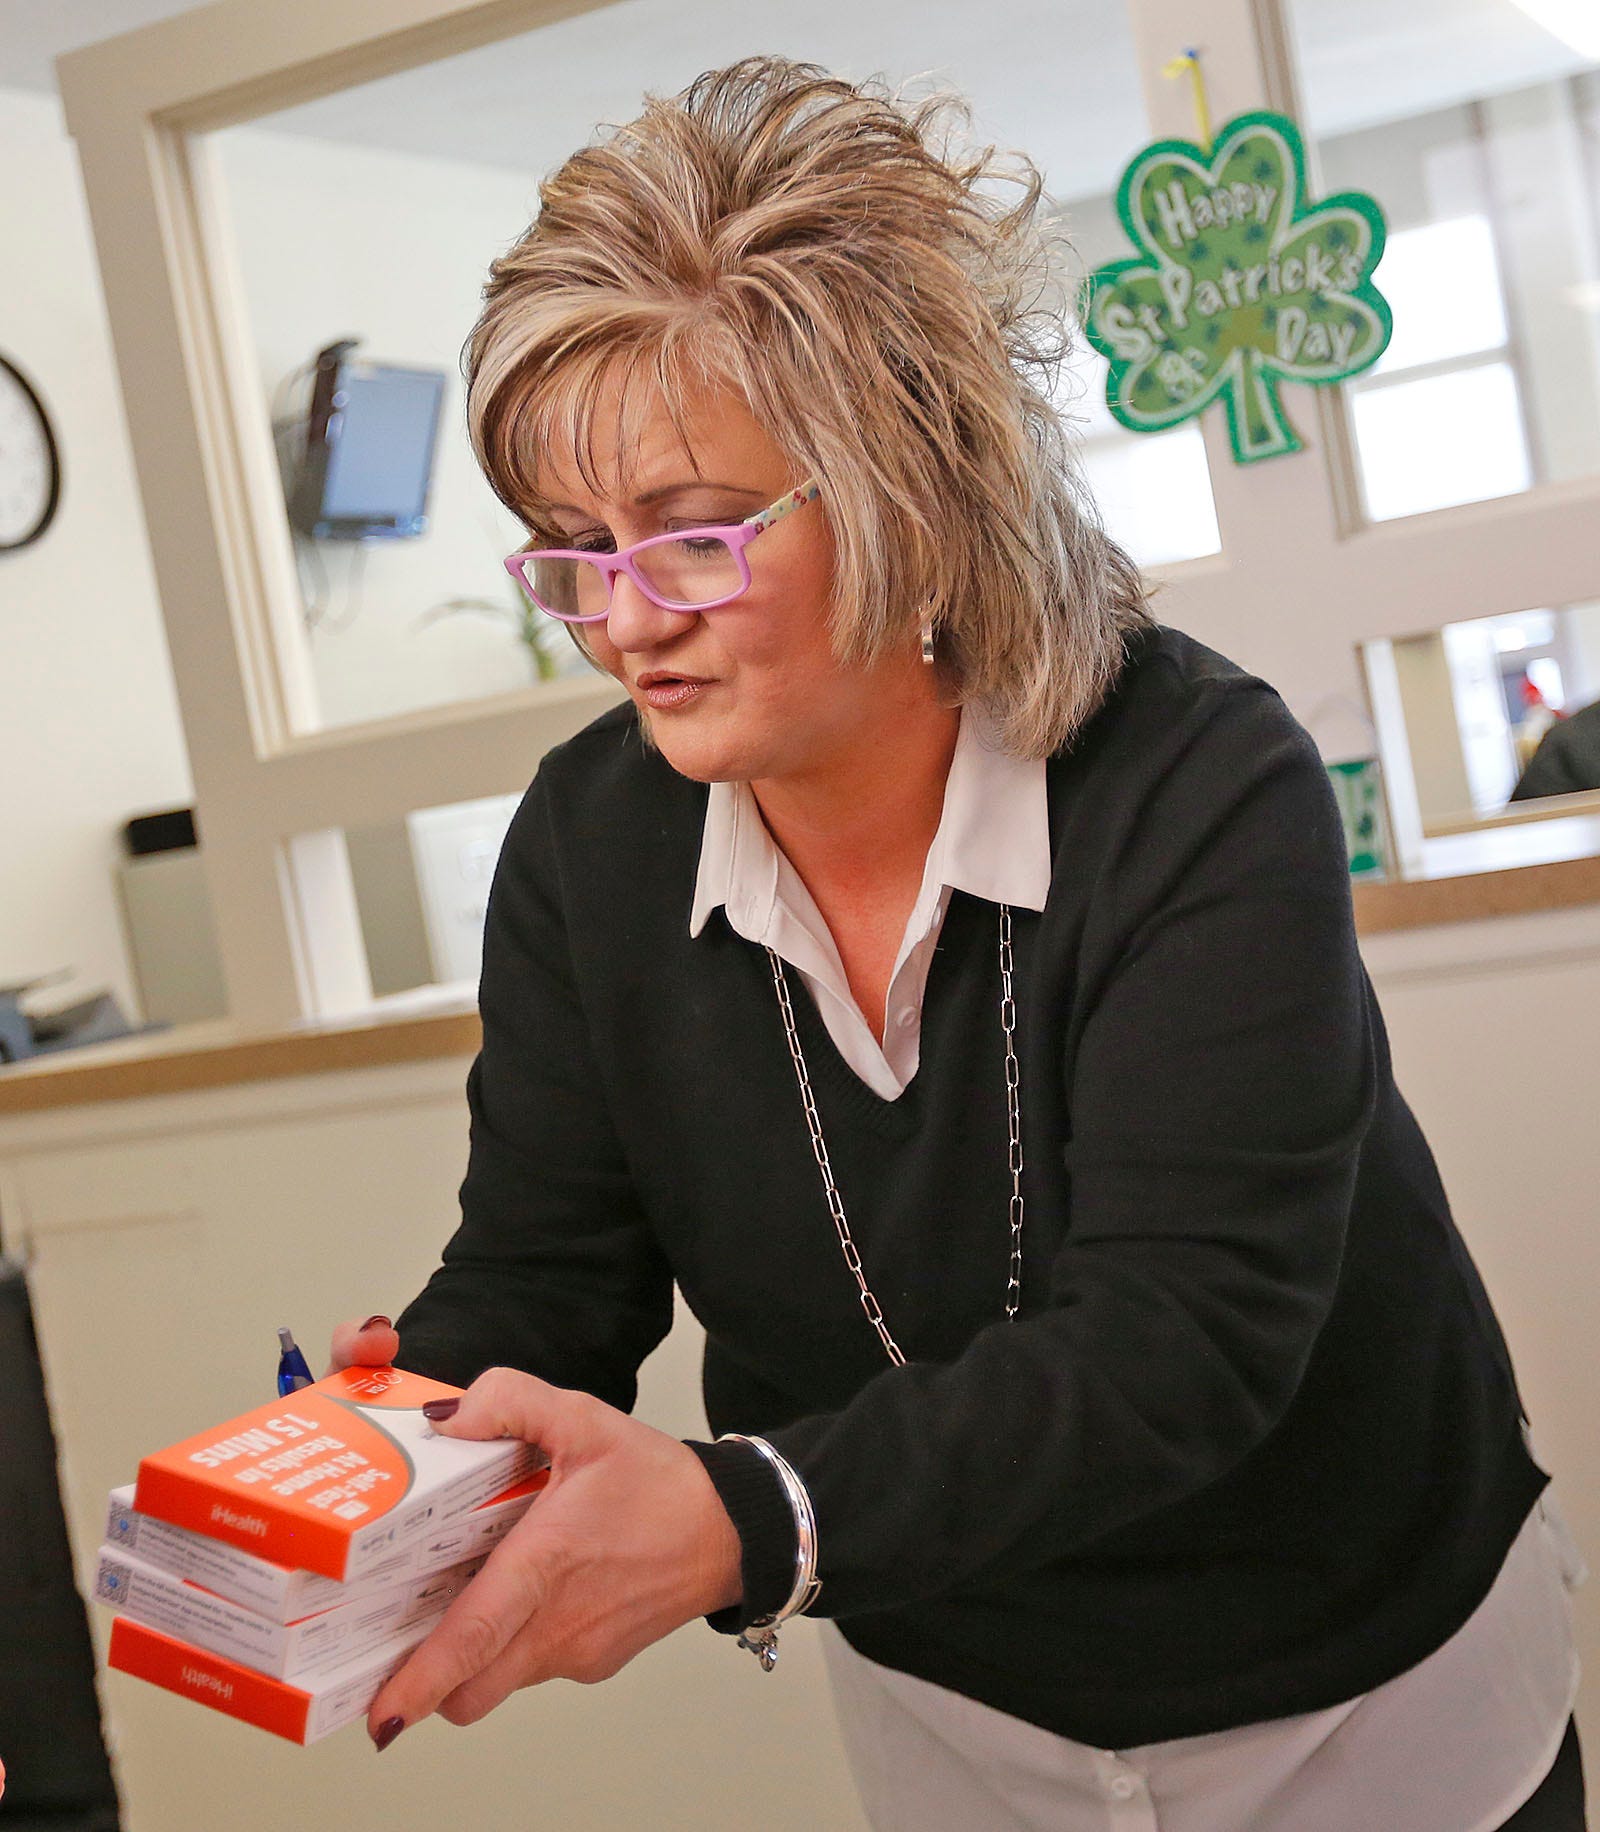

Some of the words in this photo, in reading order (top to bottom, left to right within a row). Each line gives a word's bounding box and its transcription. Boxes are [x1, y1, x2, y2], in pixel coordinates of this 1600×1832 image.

[1154, 180, 1277, 247] Happy
[1102, 302, 1168, 363] St
[1160, 243, 1364, 328] Patrick's
[1276, 306, 1357, 365] Day
[265, 1413, 319, 1438] 15
[189, 1428, 284, 1468] Mins
[259, 1435, 346, 1472] Results
[331, 1450, 369, 1468] At
[271, 1462, 348, 1496] Home
[306, 1468, 391, 1510] Self-Test
[210, 1503, 270, 1537] iHealth
[181, 1665, 234, 1700] iHealth
